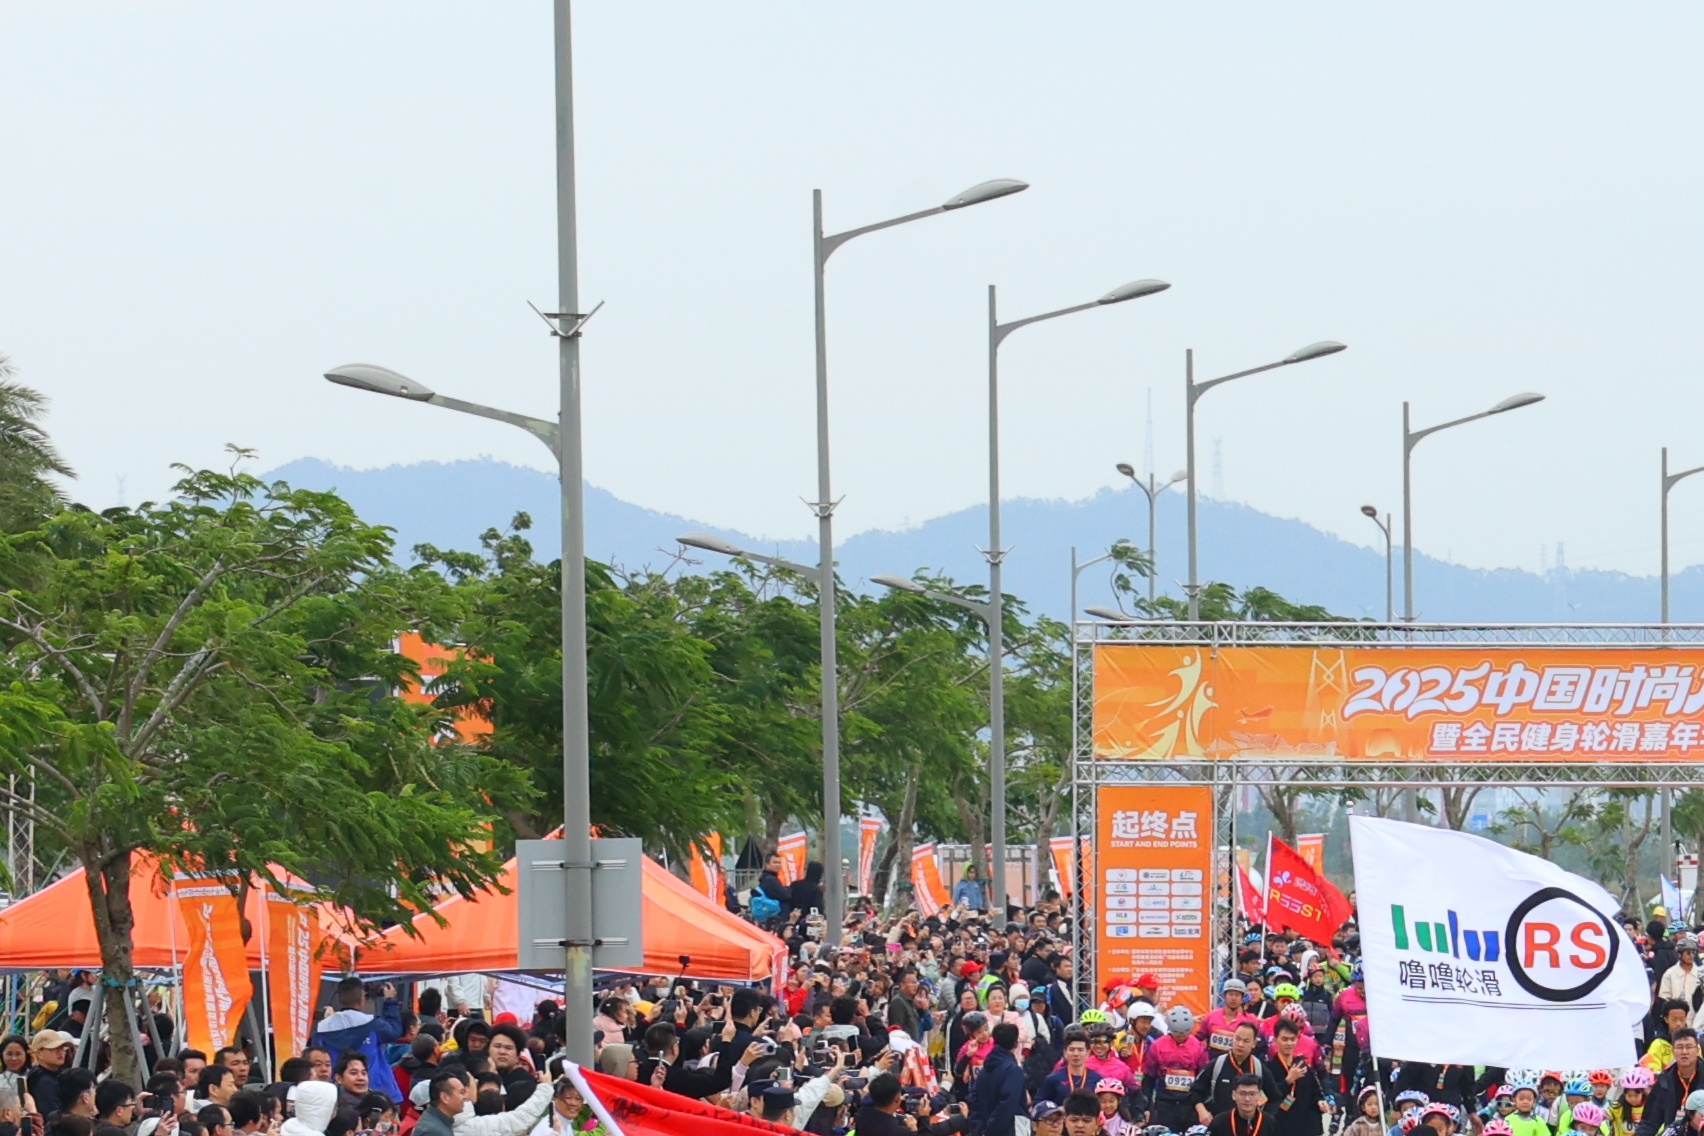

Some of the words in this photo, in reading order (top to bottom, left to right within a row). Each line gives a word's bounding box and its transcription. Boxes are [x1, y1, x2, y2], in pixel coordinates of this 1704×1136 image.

[1111, 810, 1198, 839] 起终点
[1111, 840, 1134, 848] START
[1135, 840, 1152, 848] AND
[1153, 840, 1169, 848] END
[1170, 840, 1198, 848] POINTS
[1523, 921, 1607, 969] RS
[1399, 959, 1503, 997] 噜噜轮滑
